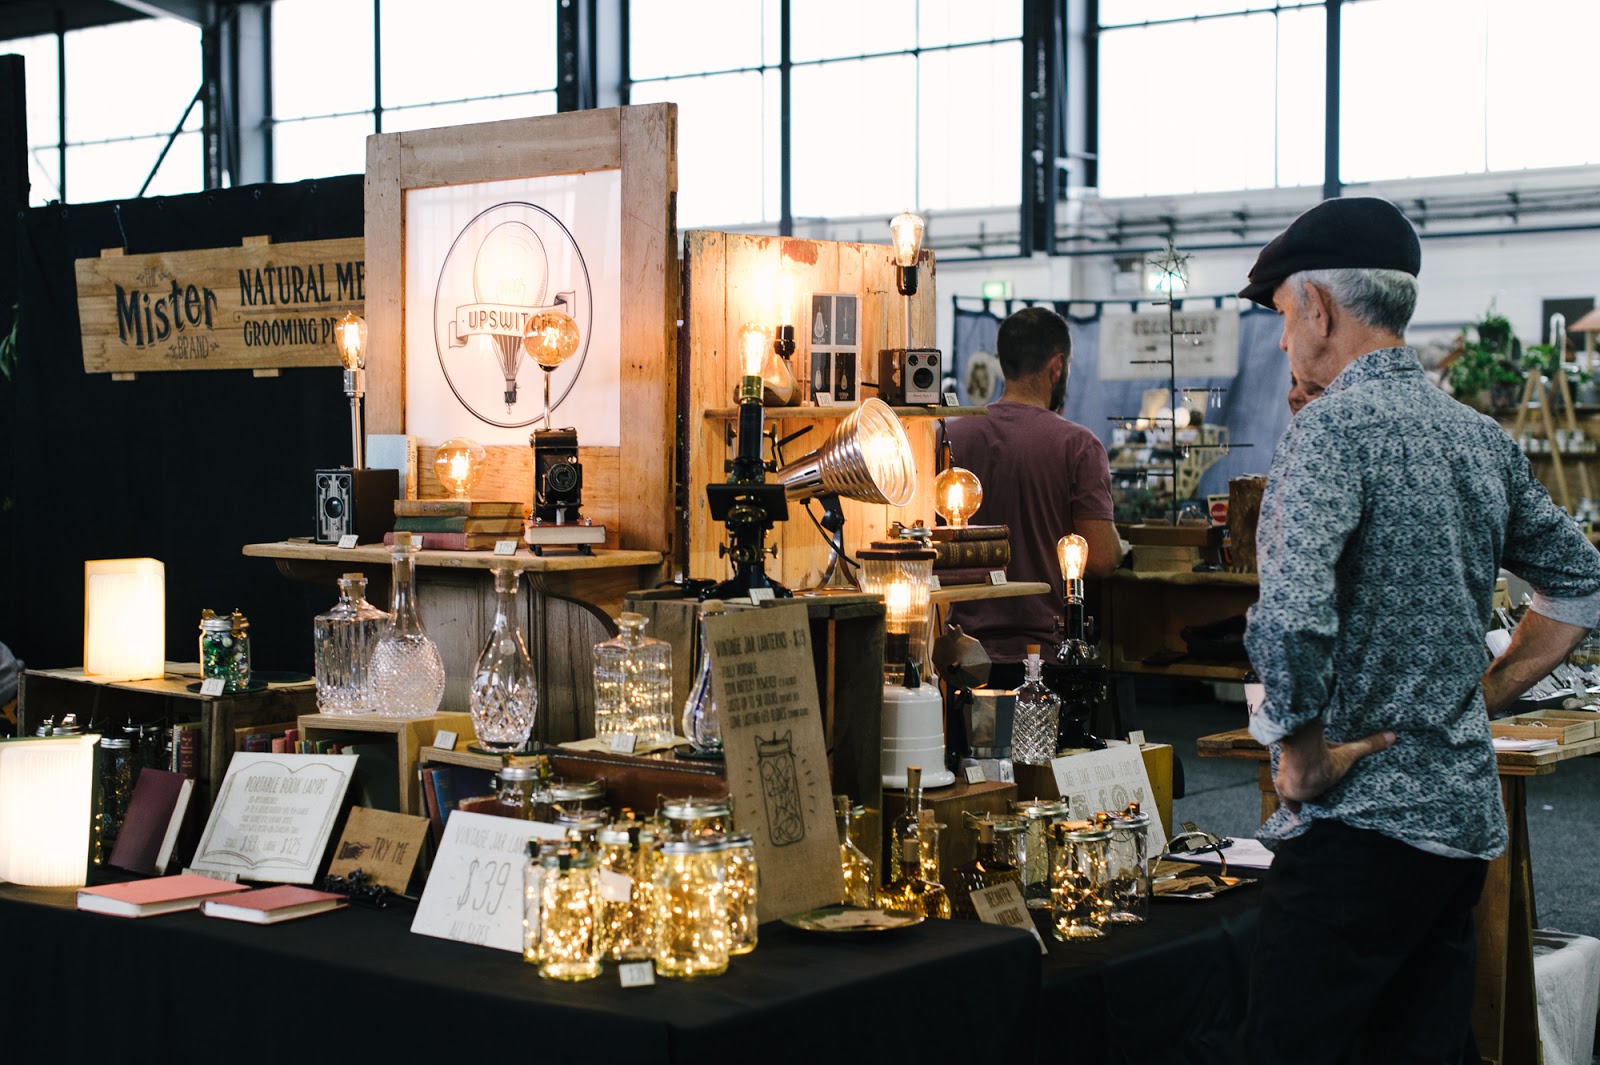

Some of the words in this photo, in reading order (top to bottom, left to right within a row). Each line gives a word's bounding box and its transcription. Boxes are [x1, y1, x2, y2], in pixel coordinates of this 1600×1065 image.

[238, 263, 331, 307] NATURAL
[114, 279, 219, 350] Mister
[243, 317, 317, 347] GROOMING
[176, 335, 209, 360] BRAND
[244, 776, 281, 793] PORTABLE
[280, 777, 303, 794] BOOK
[302, 778, 328, 794] LAMPS
[371, 837, 393, 861] TRY
[392, 841, 410, 865] ME
[456, 858, 511, 915] $39
